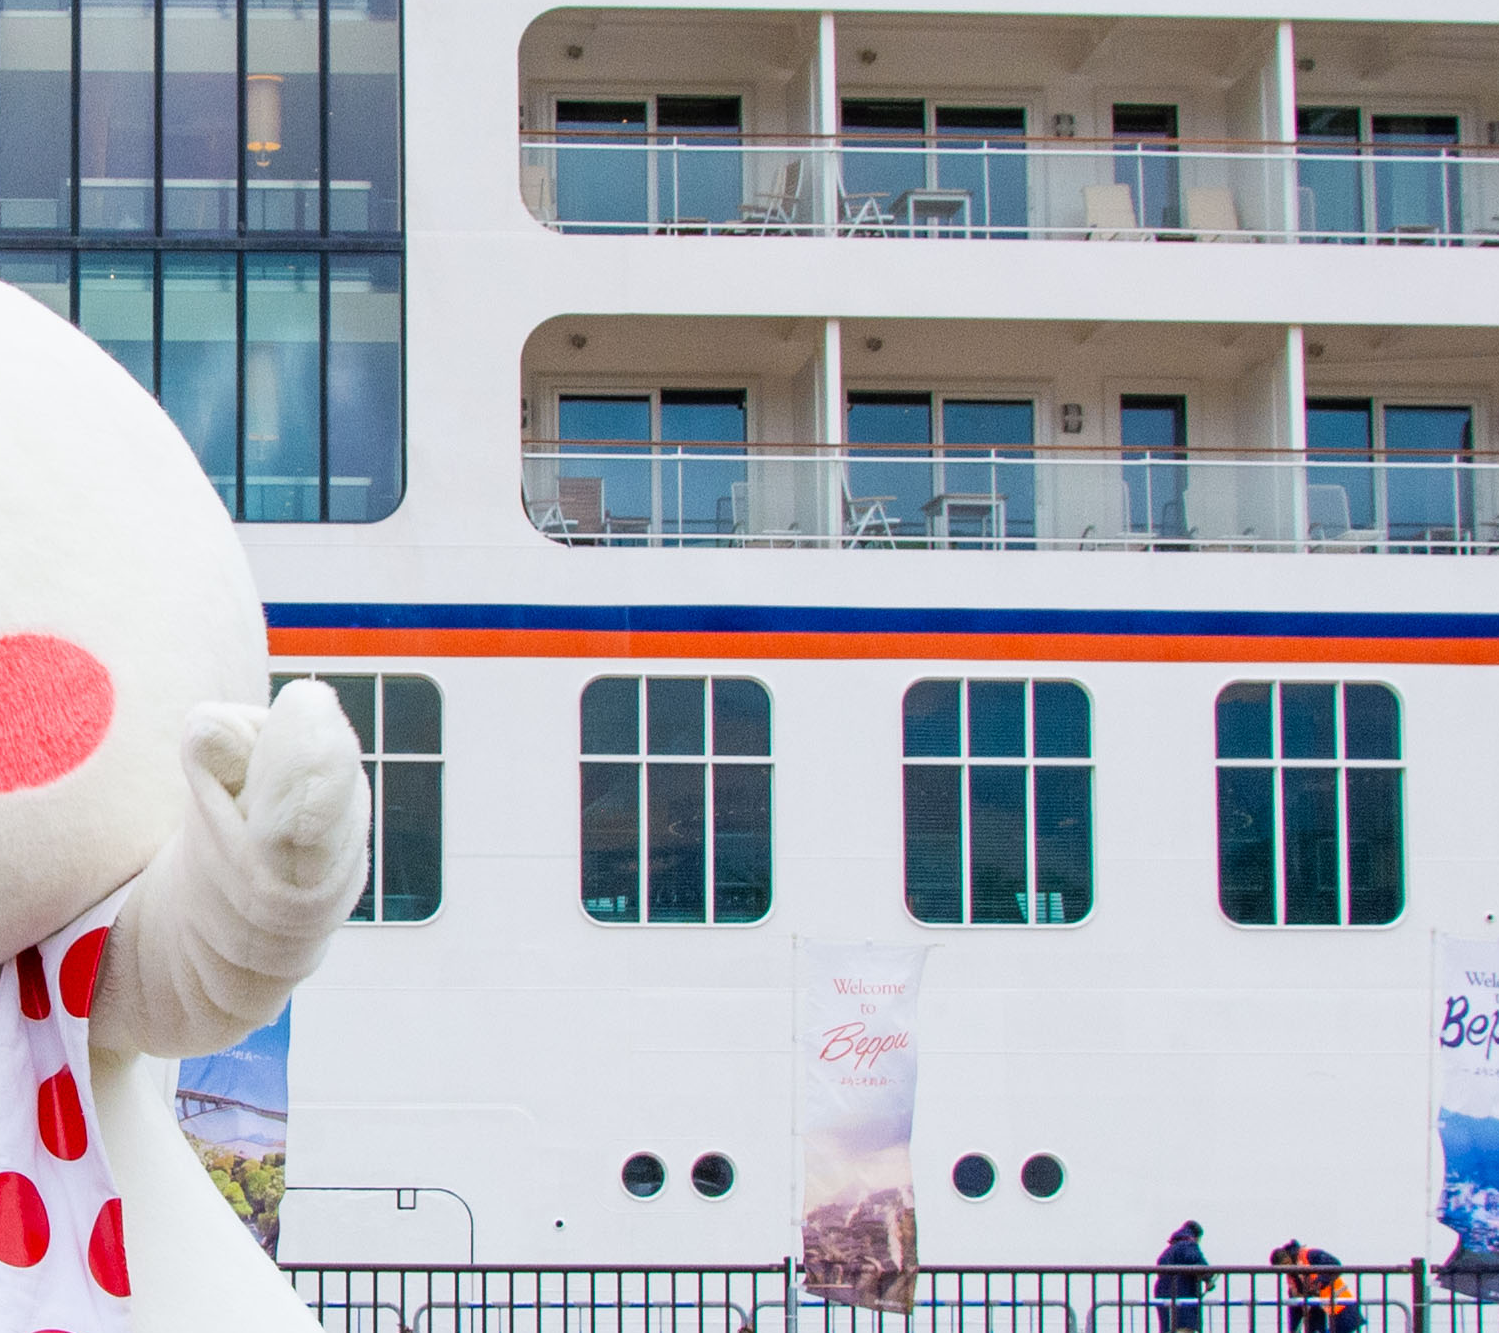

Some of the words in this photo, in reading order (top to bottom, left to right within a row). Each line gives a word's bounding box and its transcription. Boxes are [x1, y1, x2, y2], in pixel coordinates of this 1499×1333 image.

[832, 978, 907, 995] Welcome
[860, 1003, 877, 1015] to
[819, 1021, 910, 1070] Beppu
